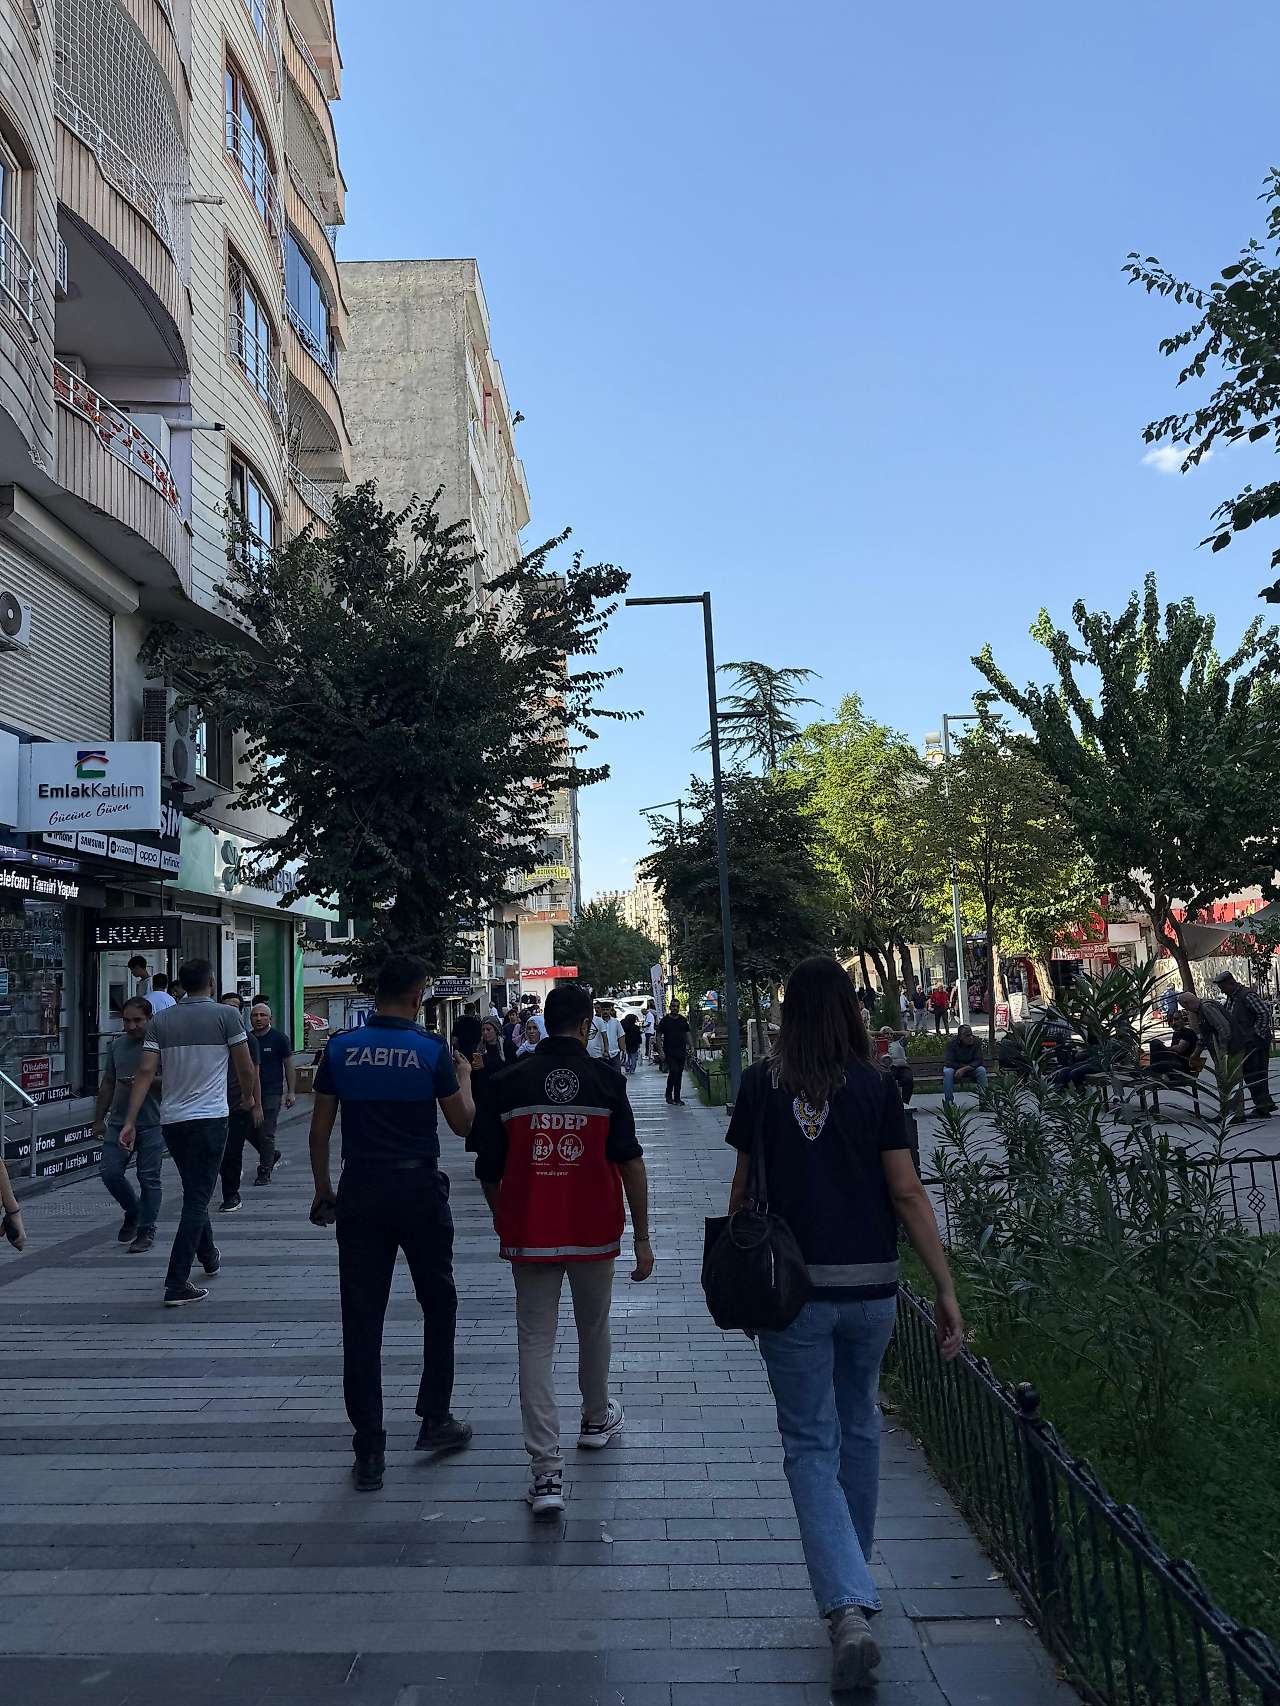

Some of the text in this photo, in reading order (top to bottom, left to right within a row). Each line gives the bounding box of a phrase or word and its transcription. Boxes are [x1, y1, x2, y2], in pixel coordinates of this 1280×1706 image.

[38, 783, 144, 798] EmlakKatılım
[48, 801, 131, 826] Gücüne Güven
[80, 836, 105, 849] SAMSUNG
[345, 1046, 420, 1069] ZABITA
[530, 1113, 588, 1130] ASDEP
[43, 1162, 64, 1176] MESUT
